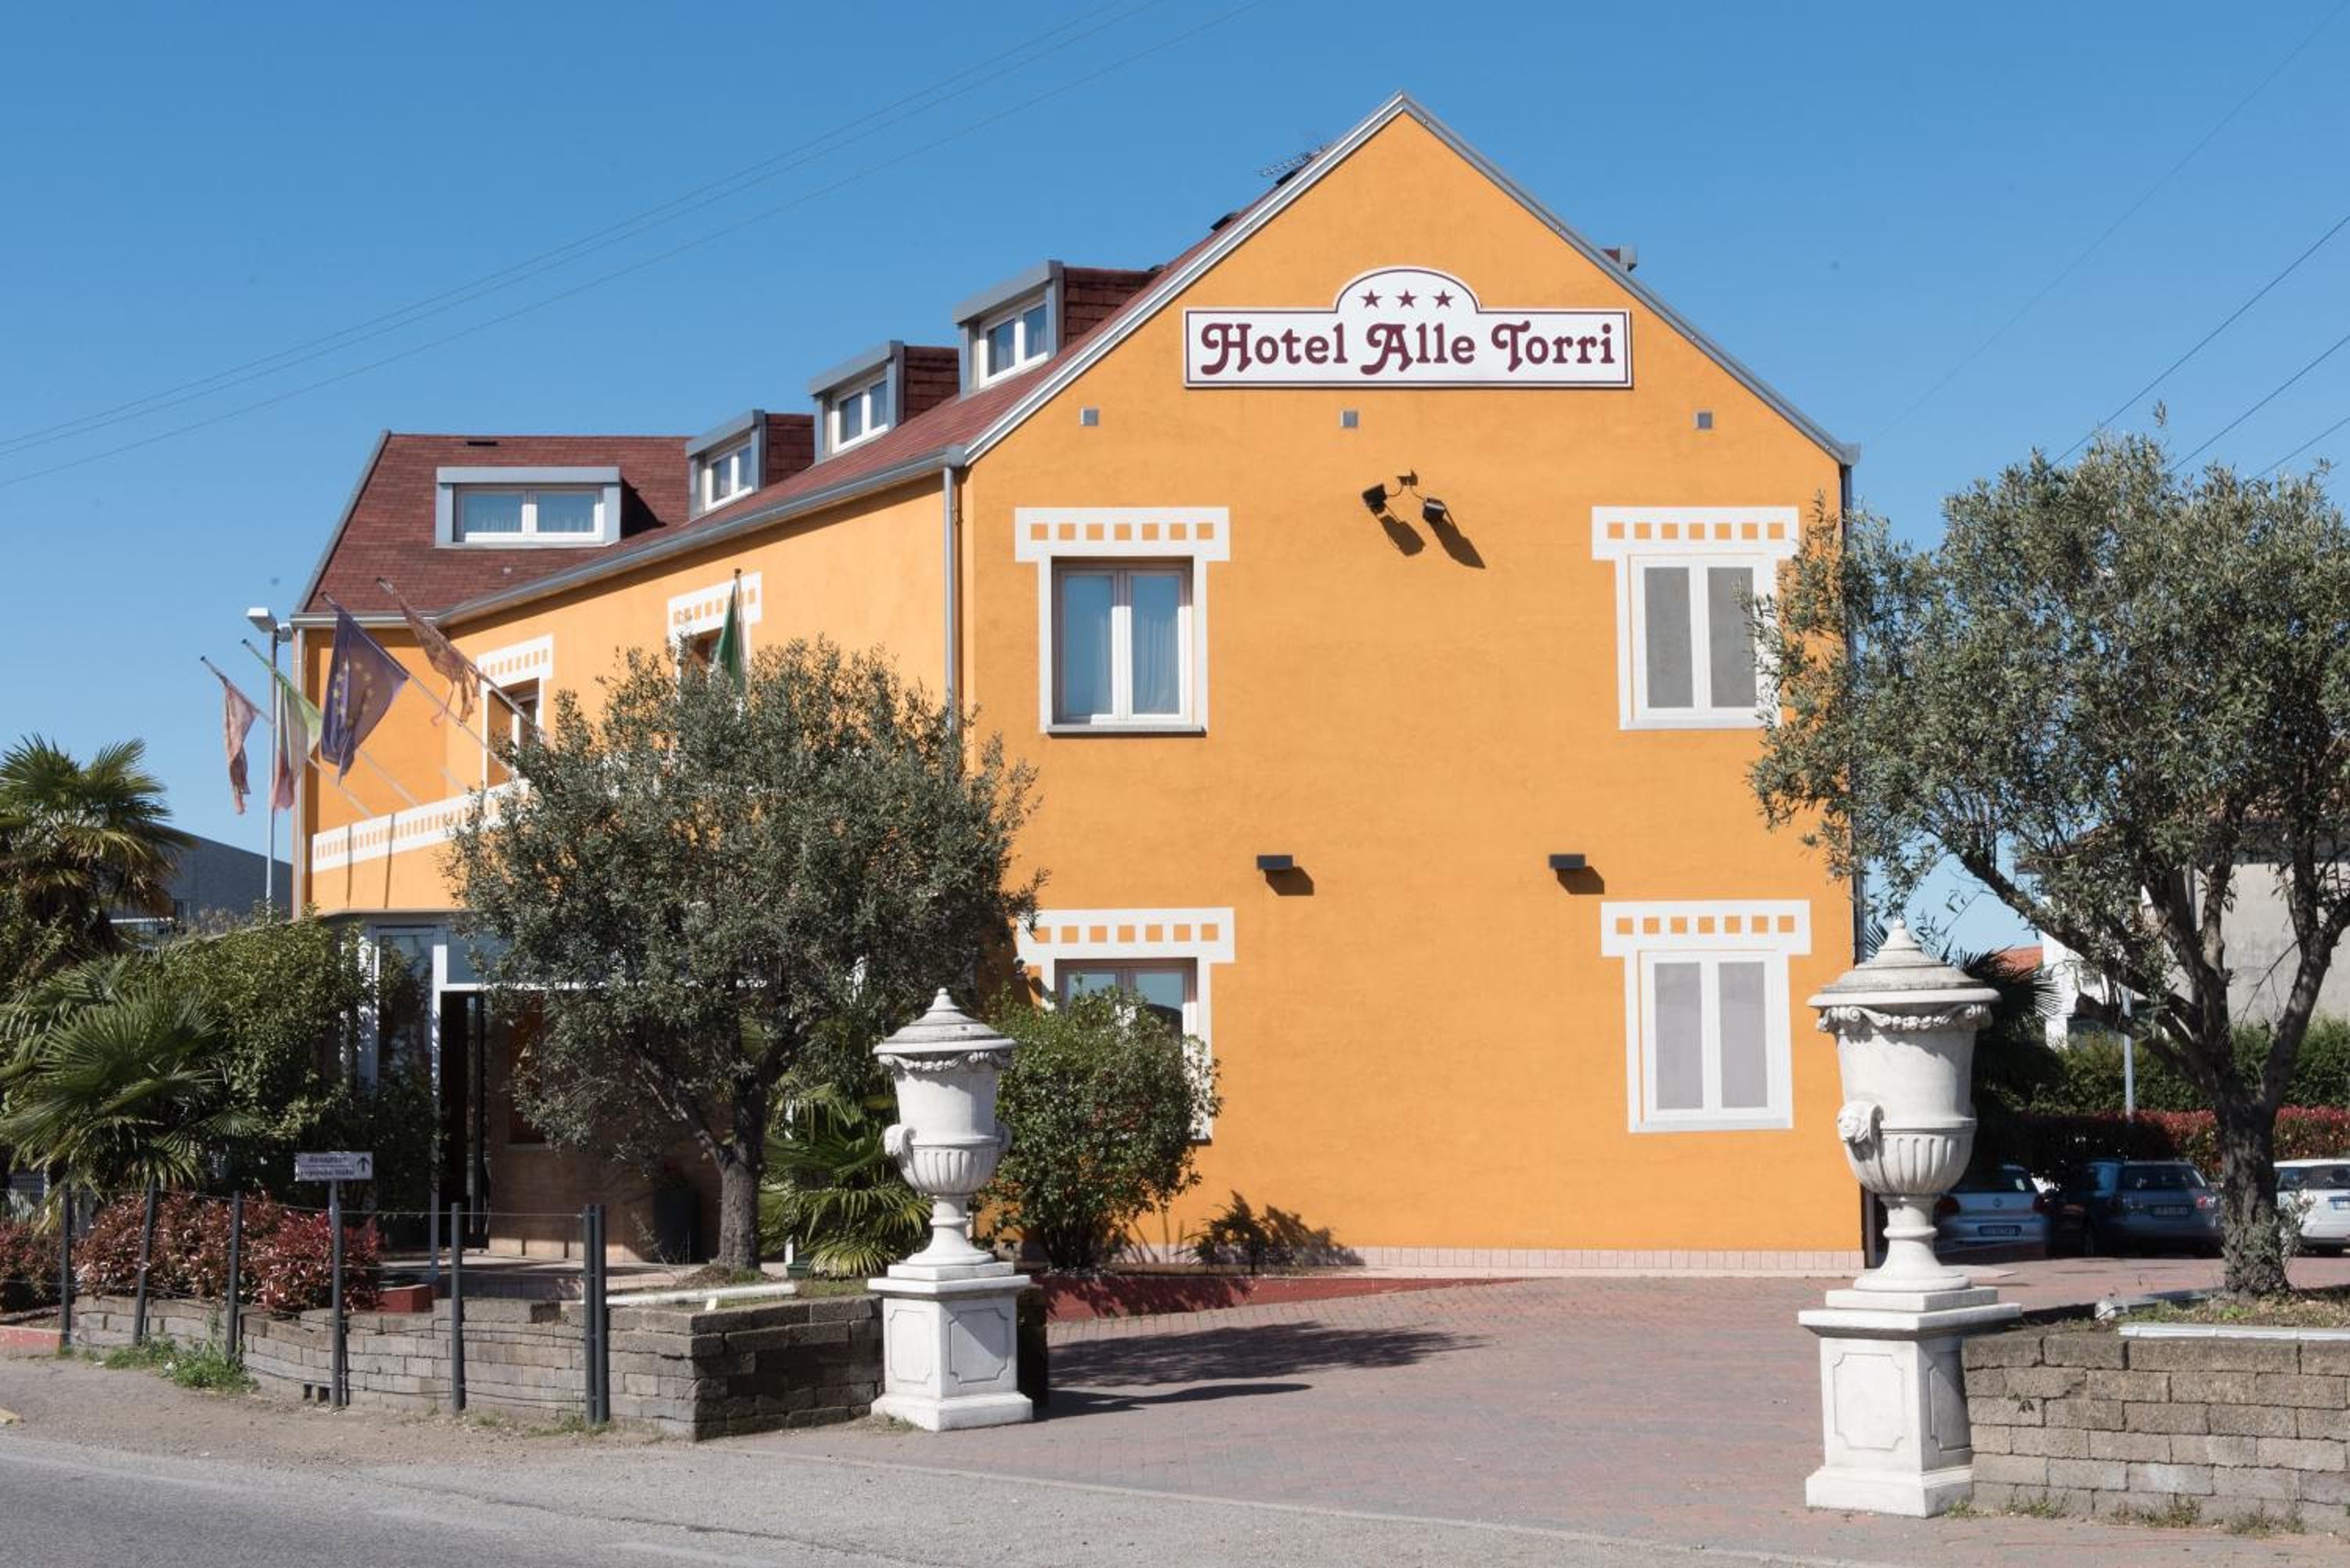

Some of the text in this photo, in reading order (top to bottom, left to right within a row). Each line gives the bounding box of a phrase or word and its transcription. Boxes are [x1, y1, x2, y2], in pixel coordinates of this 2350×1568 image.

[1200, 320, 1615, 376] Hotel Alle Torri
